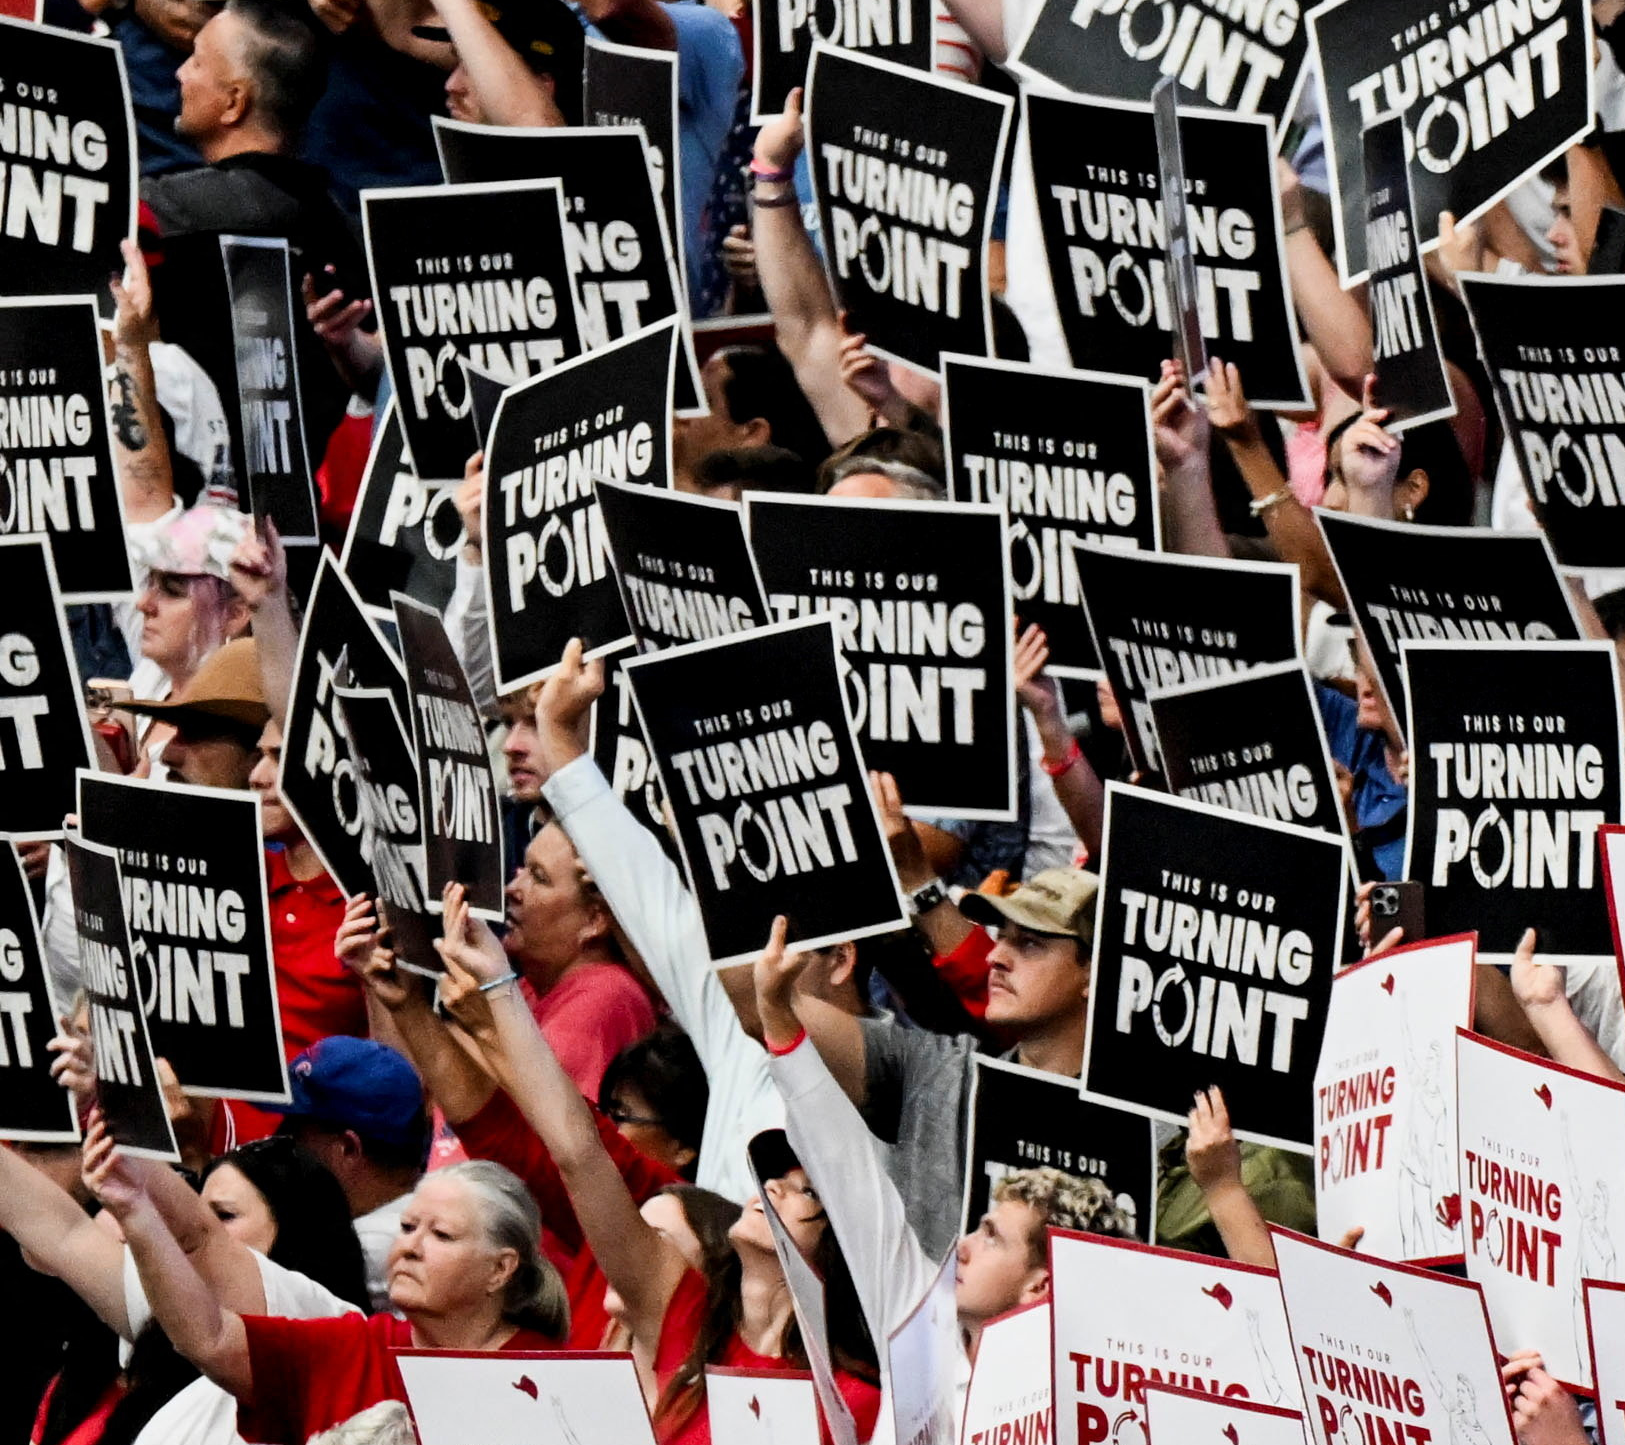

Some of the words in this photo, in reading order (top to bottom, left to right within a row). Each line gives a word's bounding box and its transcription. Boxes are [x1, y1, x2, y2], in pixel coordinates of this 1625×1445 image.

[694, 714, 731, 737] THIS
[736, 709, 754, 727] IS
[761, 700, 793, 722] OUR
[671, 720, 840, 806] TURNING
